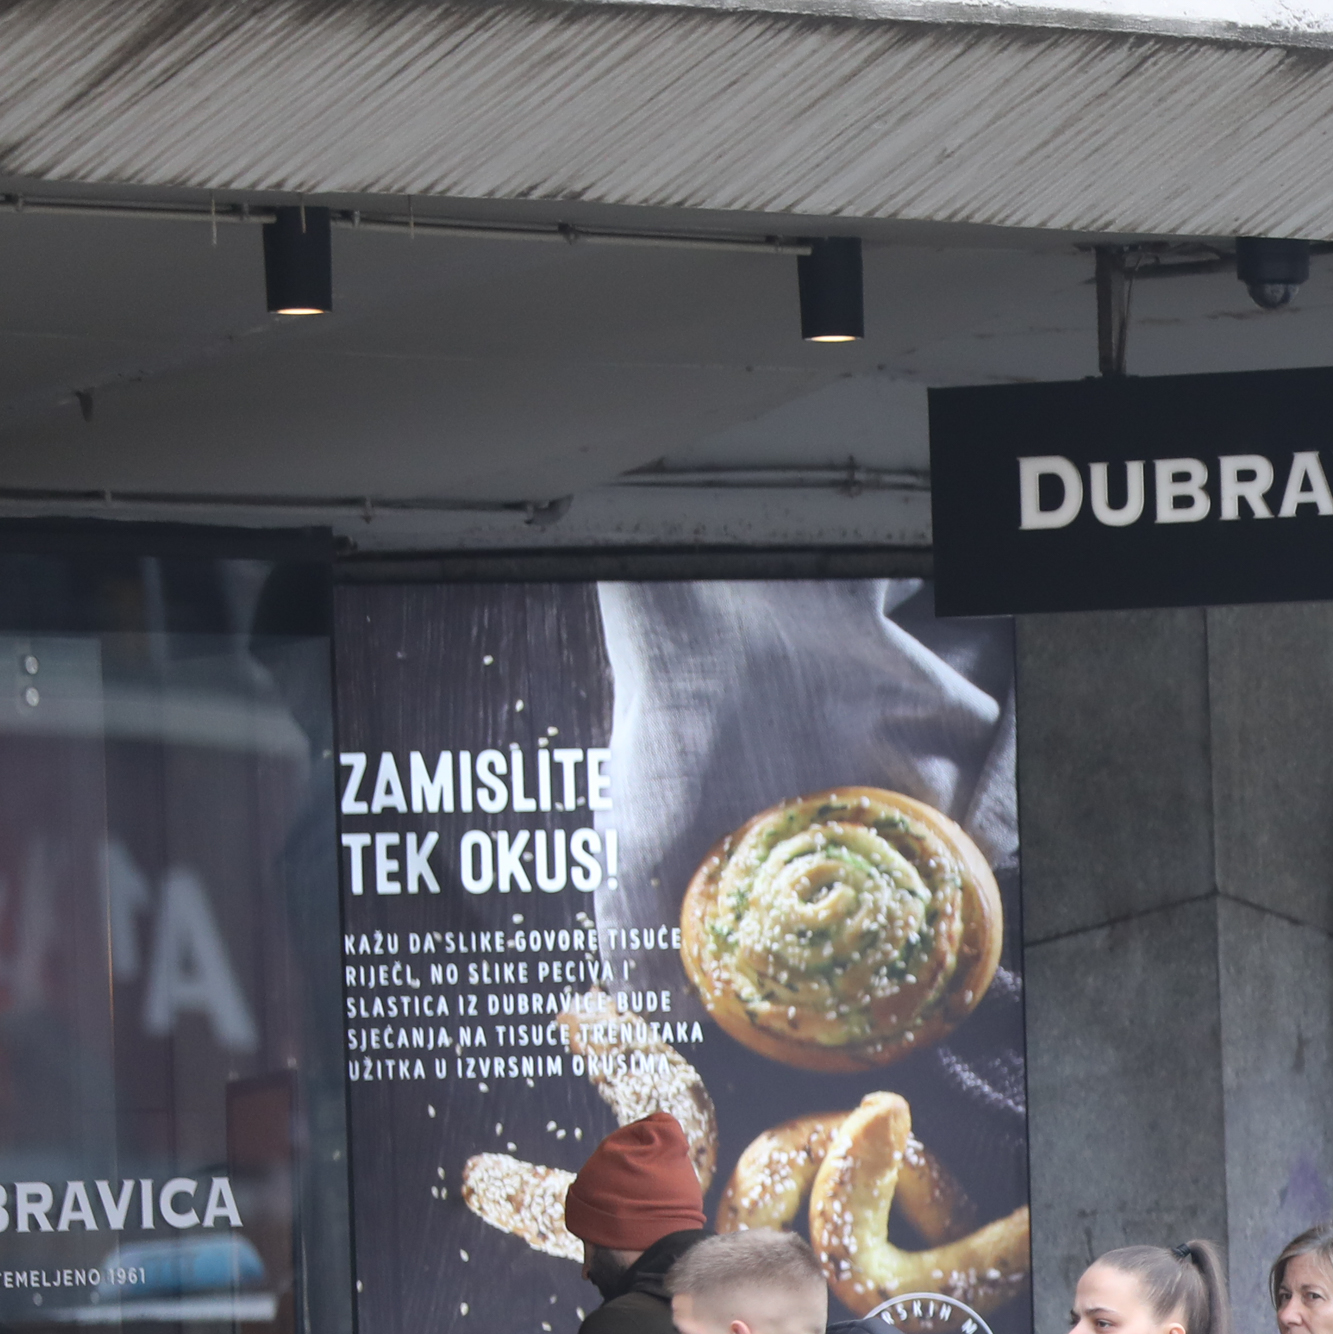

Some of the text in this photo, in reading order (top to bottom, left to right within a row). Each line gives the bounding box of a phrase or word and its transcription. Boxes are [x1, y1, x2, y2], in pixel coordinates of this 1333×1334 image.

[340, 748, 614, 815] ZAMISLITE
[341, 828, 619, 895] TEK OKUS!
[344, 924, 682, 955] KAŽU DA SLIKE GOVORE TISUĆE
[430, 963, 459, 985] NO
[468, 960, 529, 985] SLIKE
[538, 960, 614, 983] PECIVA
[623, 960, 629, 981] I
[346, 990, 672, 1018] SLASTICA IZ DUBRAVICE BUDE
[459, 1025, 487, 1047] NA
[580, 1020, 704, 1045] TRENUTAKA
[349, 1053, 671, 1081] UŽITKA U IZVRSNIM OKUSIMA
[0, 1267, 146, 1288] EMELJENO 1961
